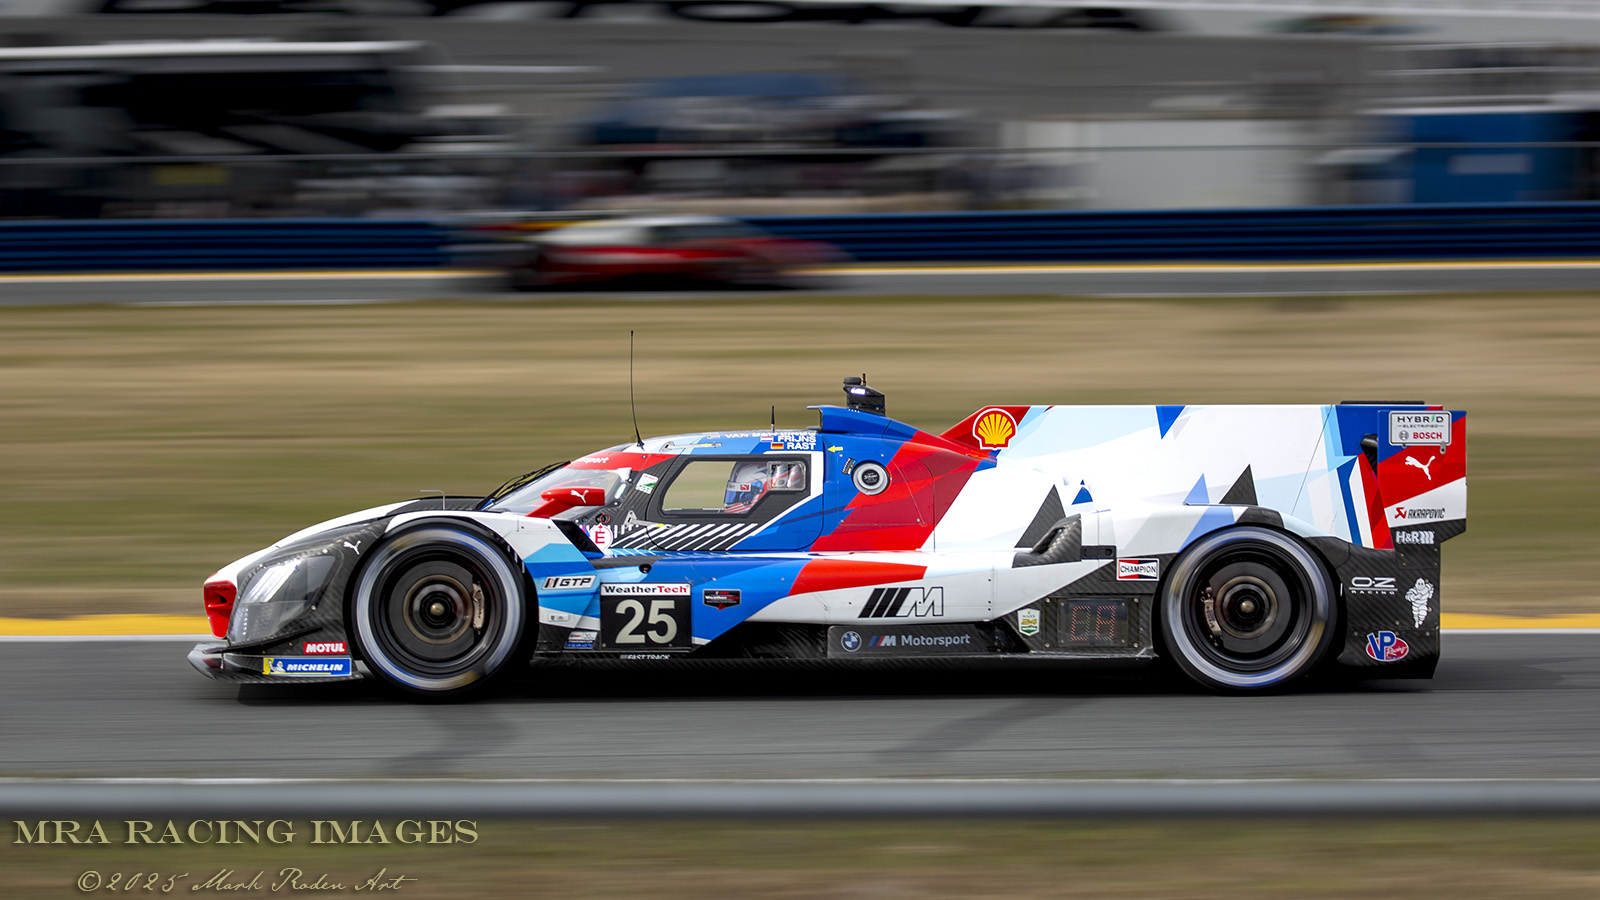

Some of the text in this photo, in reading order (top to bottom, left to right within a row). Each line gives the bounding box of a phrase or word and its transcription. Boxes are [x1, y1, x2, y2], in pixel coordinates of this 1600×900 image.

[1397, 415, 1444, 423] HYBRID
[595, 531, 605, 544] E
[1120, 565, 1157, 574] CHAMPION
[559, 578, 592, 587] GTP
[615, 599, 677, 644] 25
[901, 634, 970, 647] Motorsport
[1367, 630, 1396, 660] VP
[305, 643, 345, 653] MOTUL
[286, 663, 343, 671] MICHELIN
